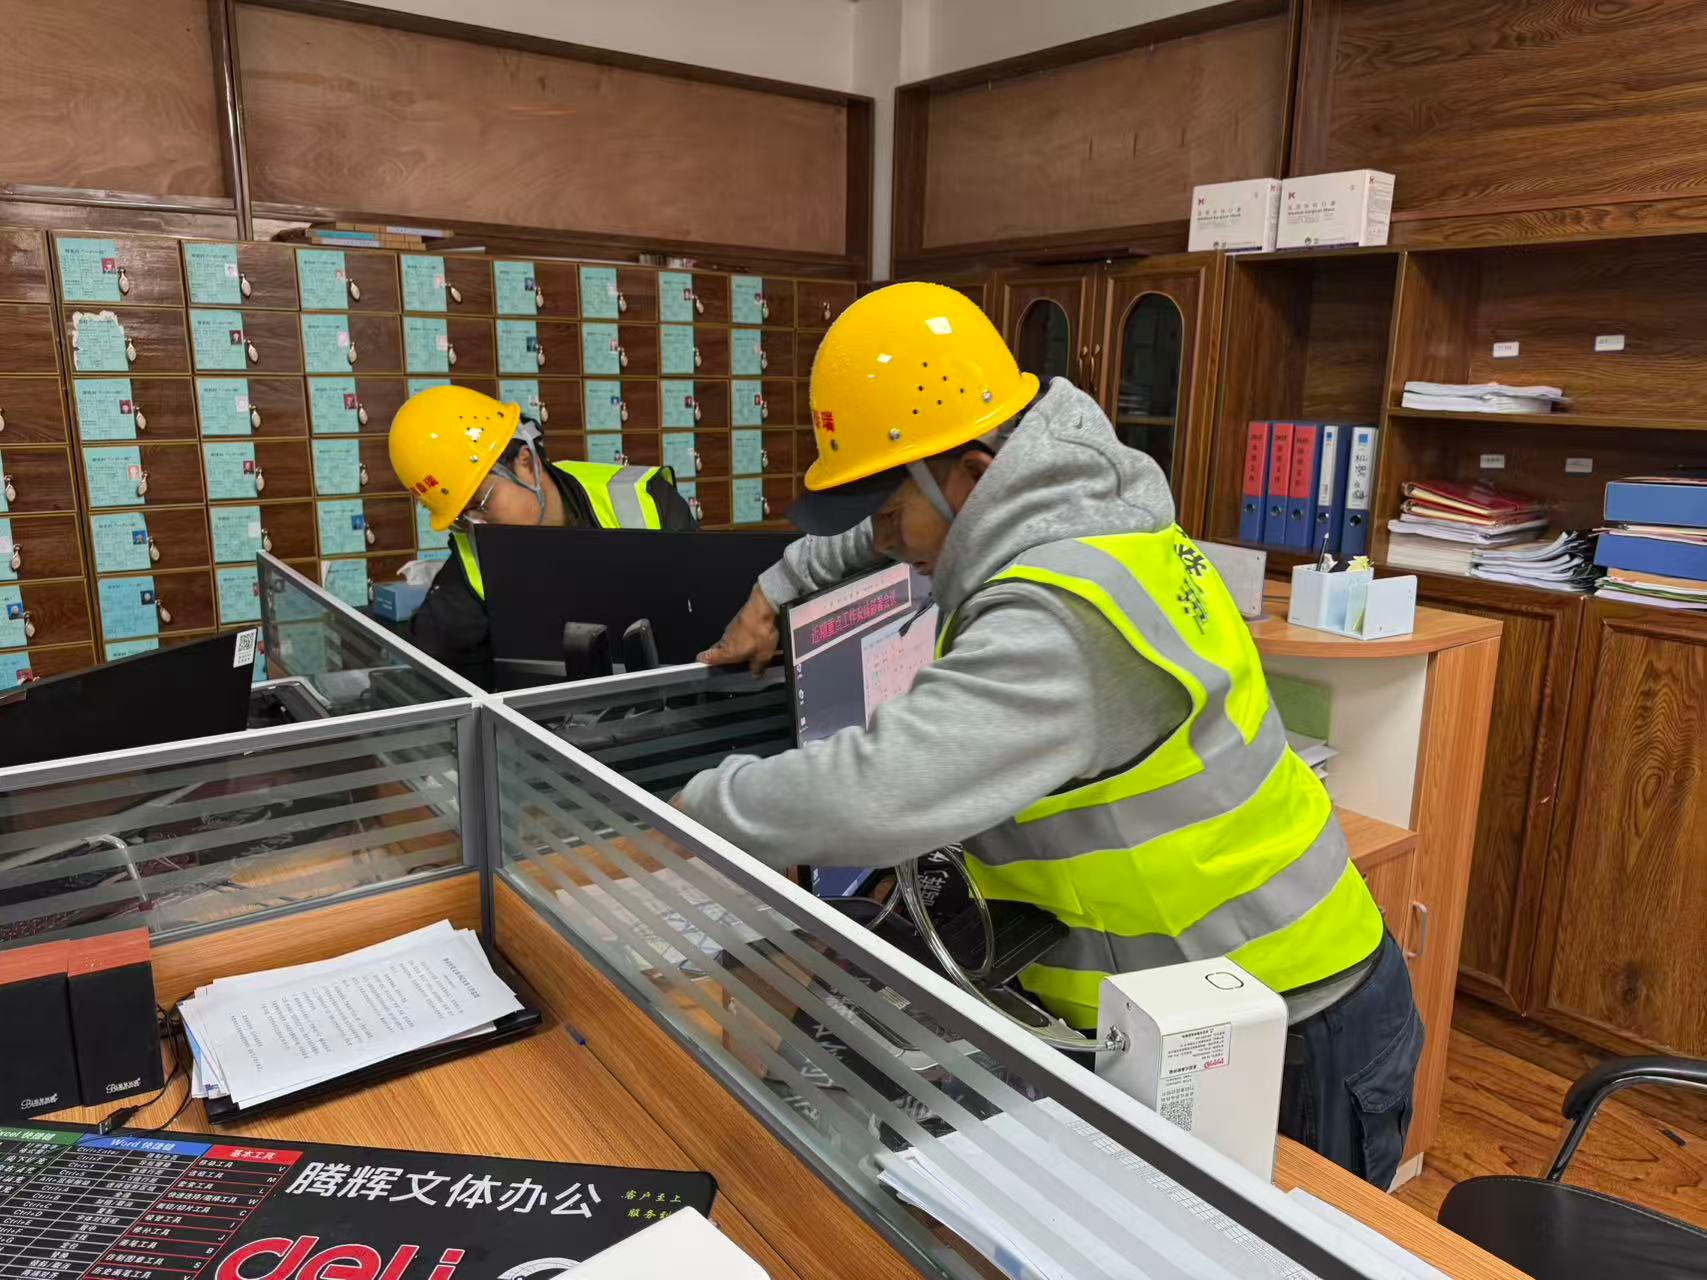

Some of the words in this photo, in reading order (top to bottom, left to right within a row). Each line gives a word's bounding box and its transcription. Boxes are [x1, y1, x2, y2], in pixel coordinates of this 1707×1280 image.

[21, 1131, 57, 1141] 快捷键
[111, 1138, 141, 1149] Word
[141, 1140, 176, 1151] 快捷键
[229, 1149, 277, 1160] 基本工具
[198, 1159, 234, 1168] 移动工具
[188, 1170, 224, 1180] 选框工具
[286, 1161, 602, 1219] 腾辉文体办公
[625, 1189, 681, 1203] 客户至上
[23, 1201, 52, 1209] Ctrl+C
[13, 1209, 43, 1218] Ctrl+D
[3, 1218, 33, 1226] Ctrl+E
[214, 1235, 466, 1280] deli
